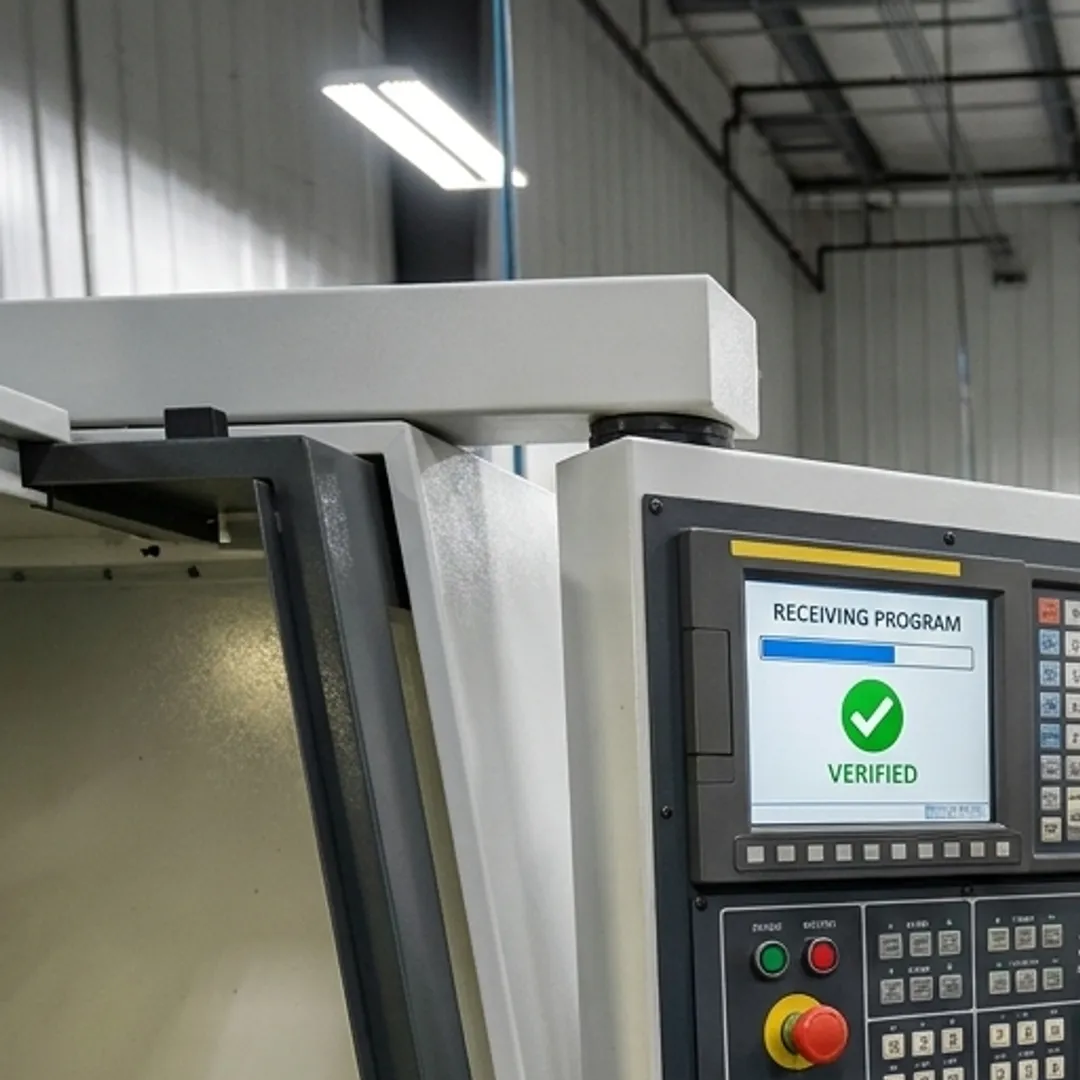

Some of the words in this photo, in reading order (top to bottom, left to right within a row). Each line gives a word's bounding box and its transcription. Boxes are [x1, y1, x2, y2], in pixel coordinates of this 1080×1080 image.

[773, 603, 869, 627] RECEIVING
[875, 610, 961, 632] PROGRAM
[828, 763, 917, 784] VERIFIED
